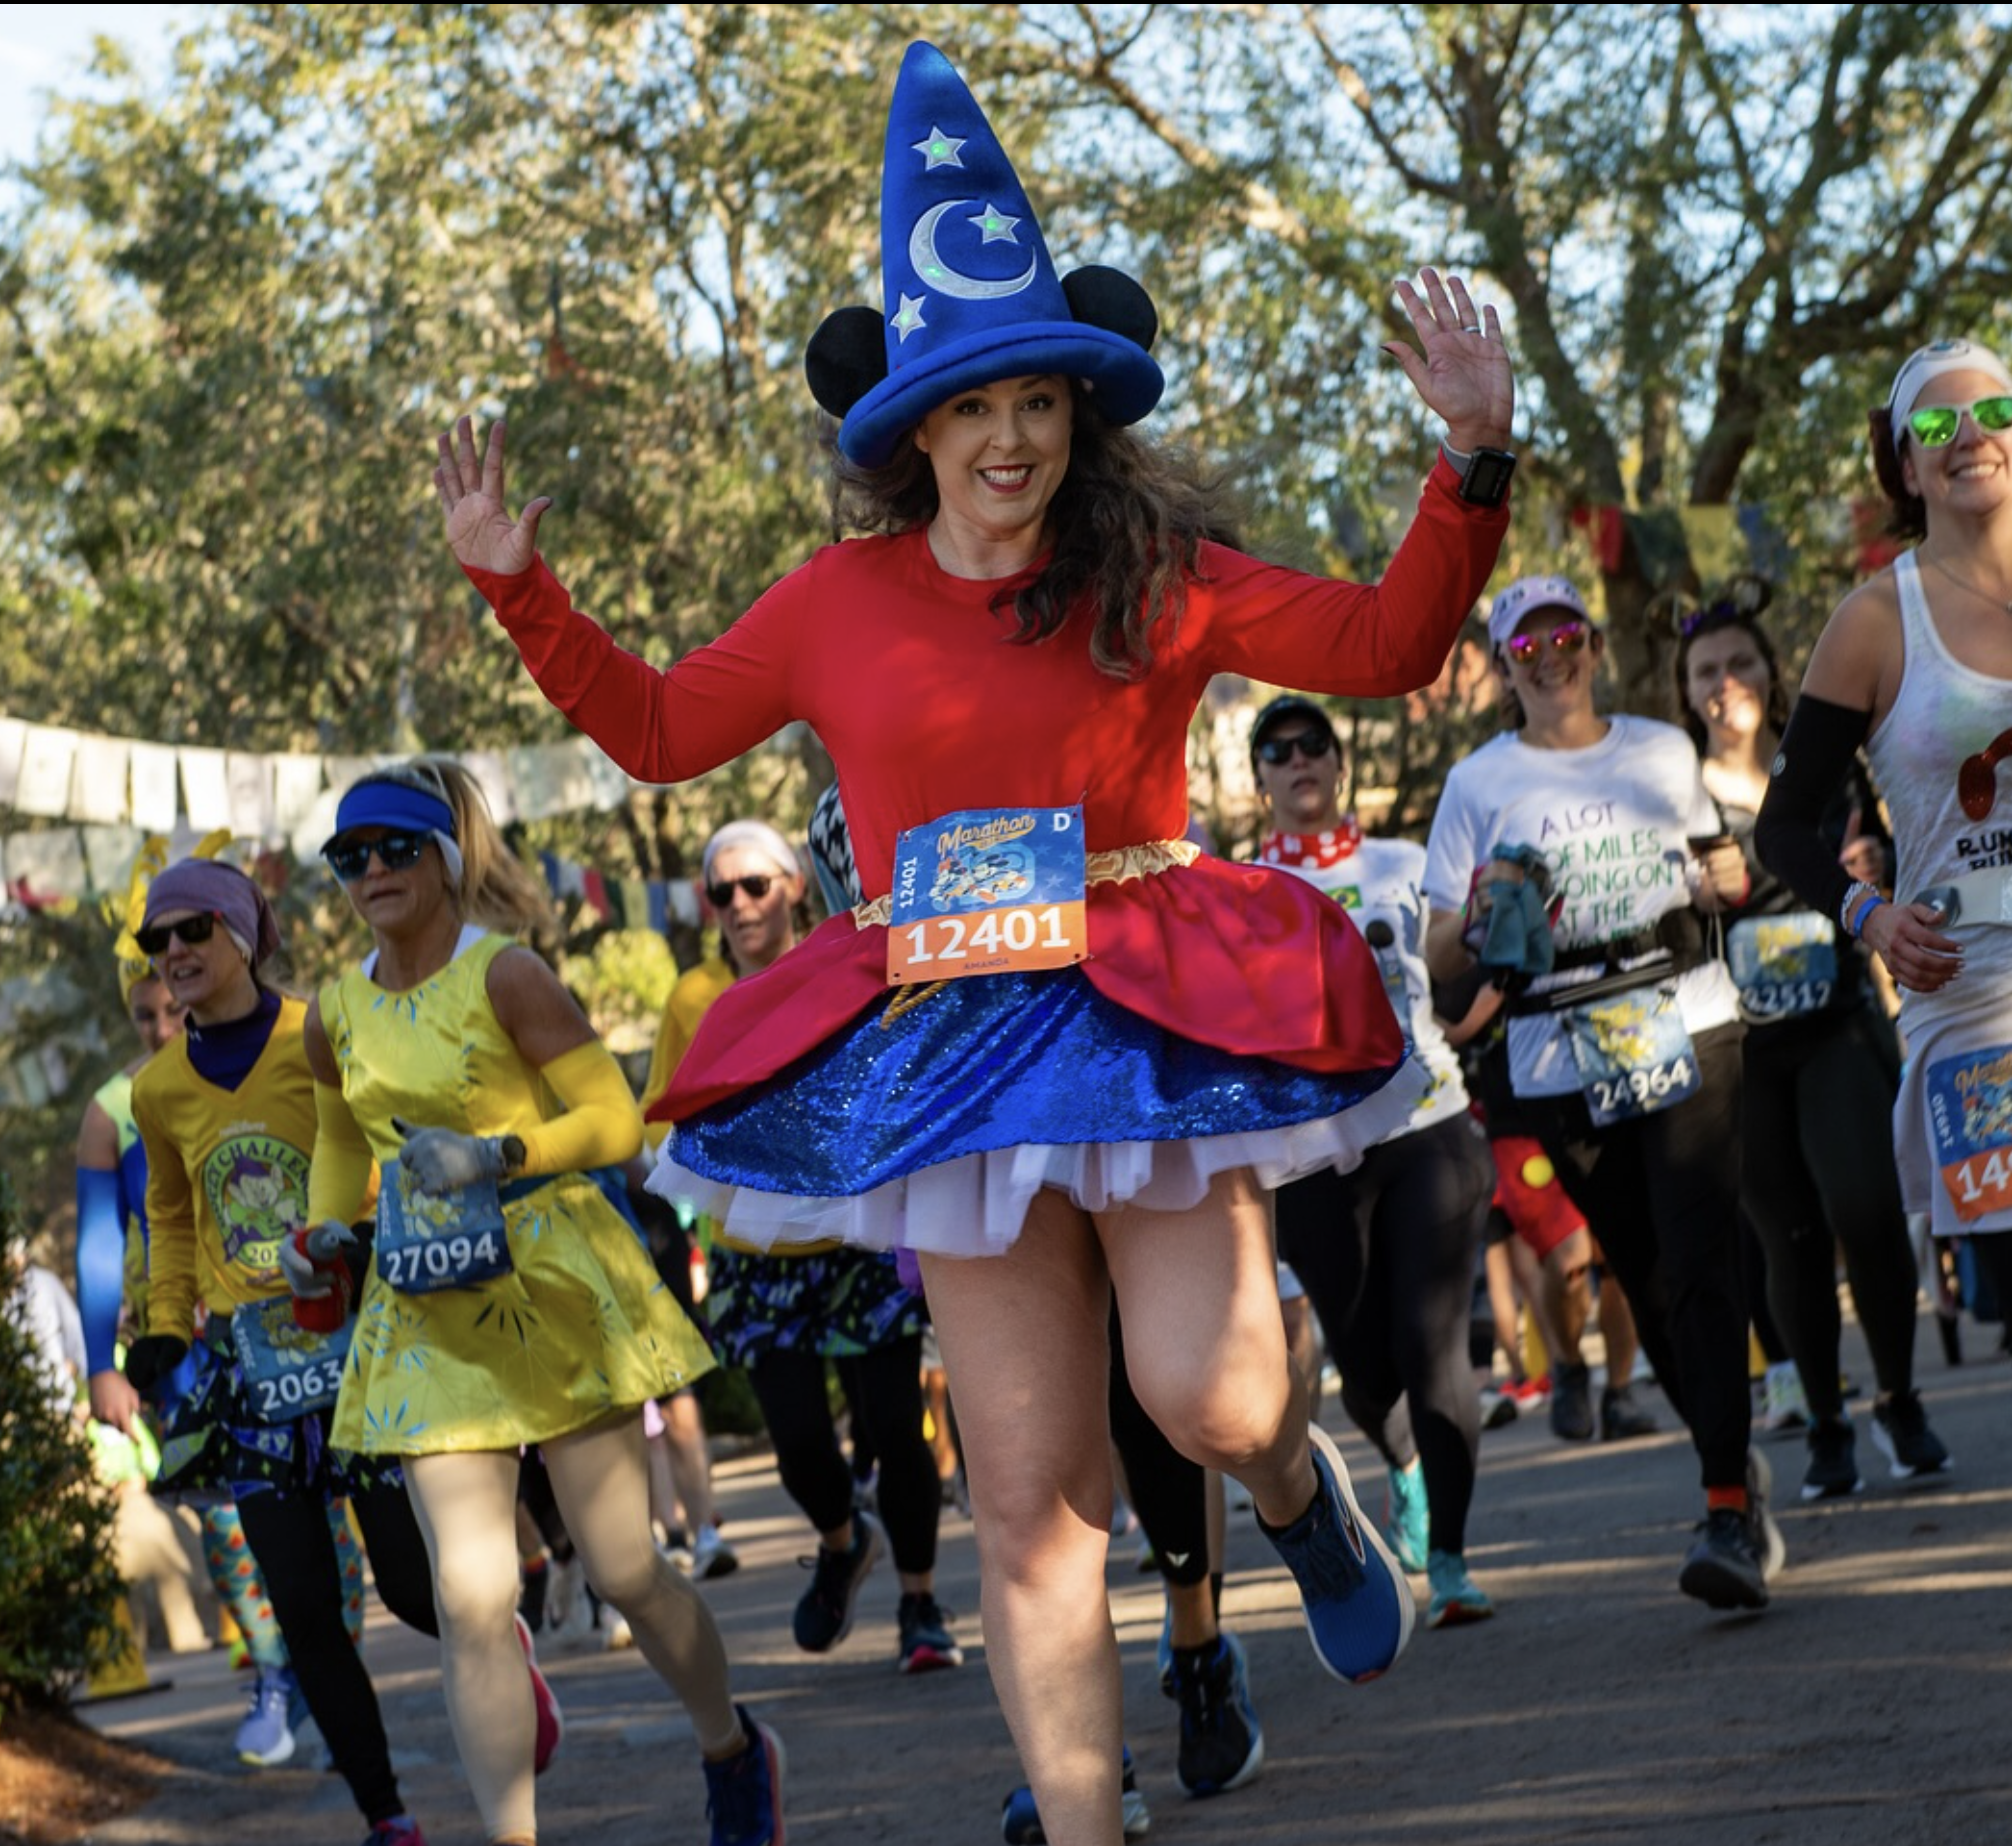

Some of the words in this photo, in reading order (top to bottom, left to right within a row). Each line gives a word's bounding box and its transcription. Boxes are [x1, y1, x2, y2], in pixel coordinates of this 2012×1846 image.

[937, 814, 1037, 858] Marathon
[1053, 813, 1071, 832] D
[1541, 814, 1559, 843] A
[1565, 801, 1615, 833] LOT
[1584, 828, 1661, 863] MILES
[899, 856, 918, 909] 12401
[1635, 861, 1673, 888] ON
[1590, 894, 1638, 928] THE
[906, 906, 1071, 965] 12401
[1593, 1056, 1692, 1112] 24964
[1956, 1151, 2012, 1204] 14
[386, 1231, 499, 1285] 27094
[257, 1358, 343, 1412] 2063
